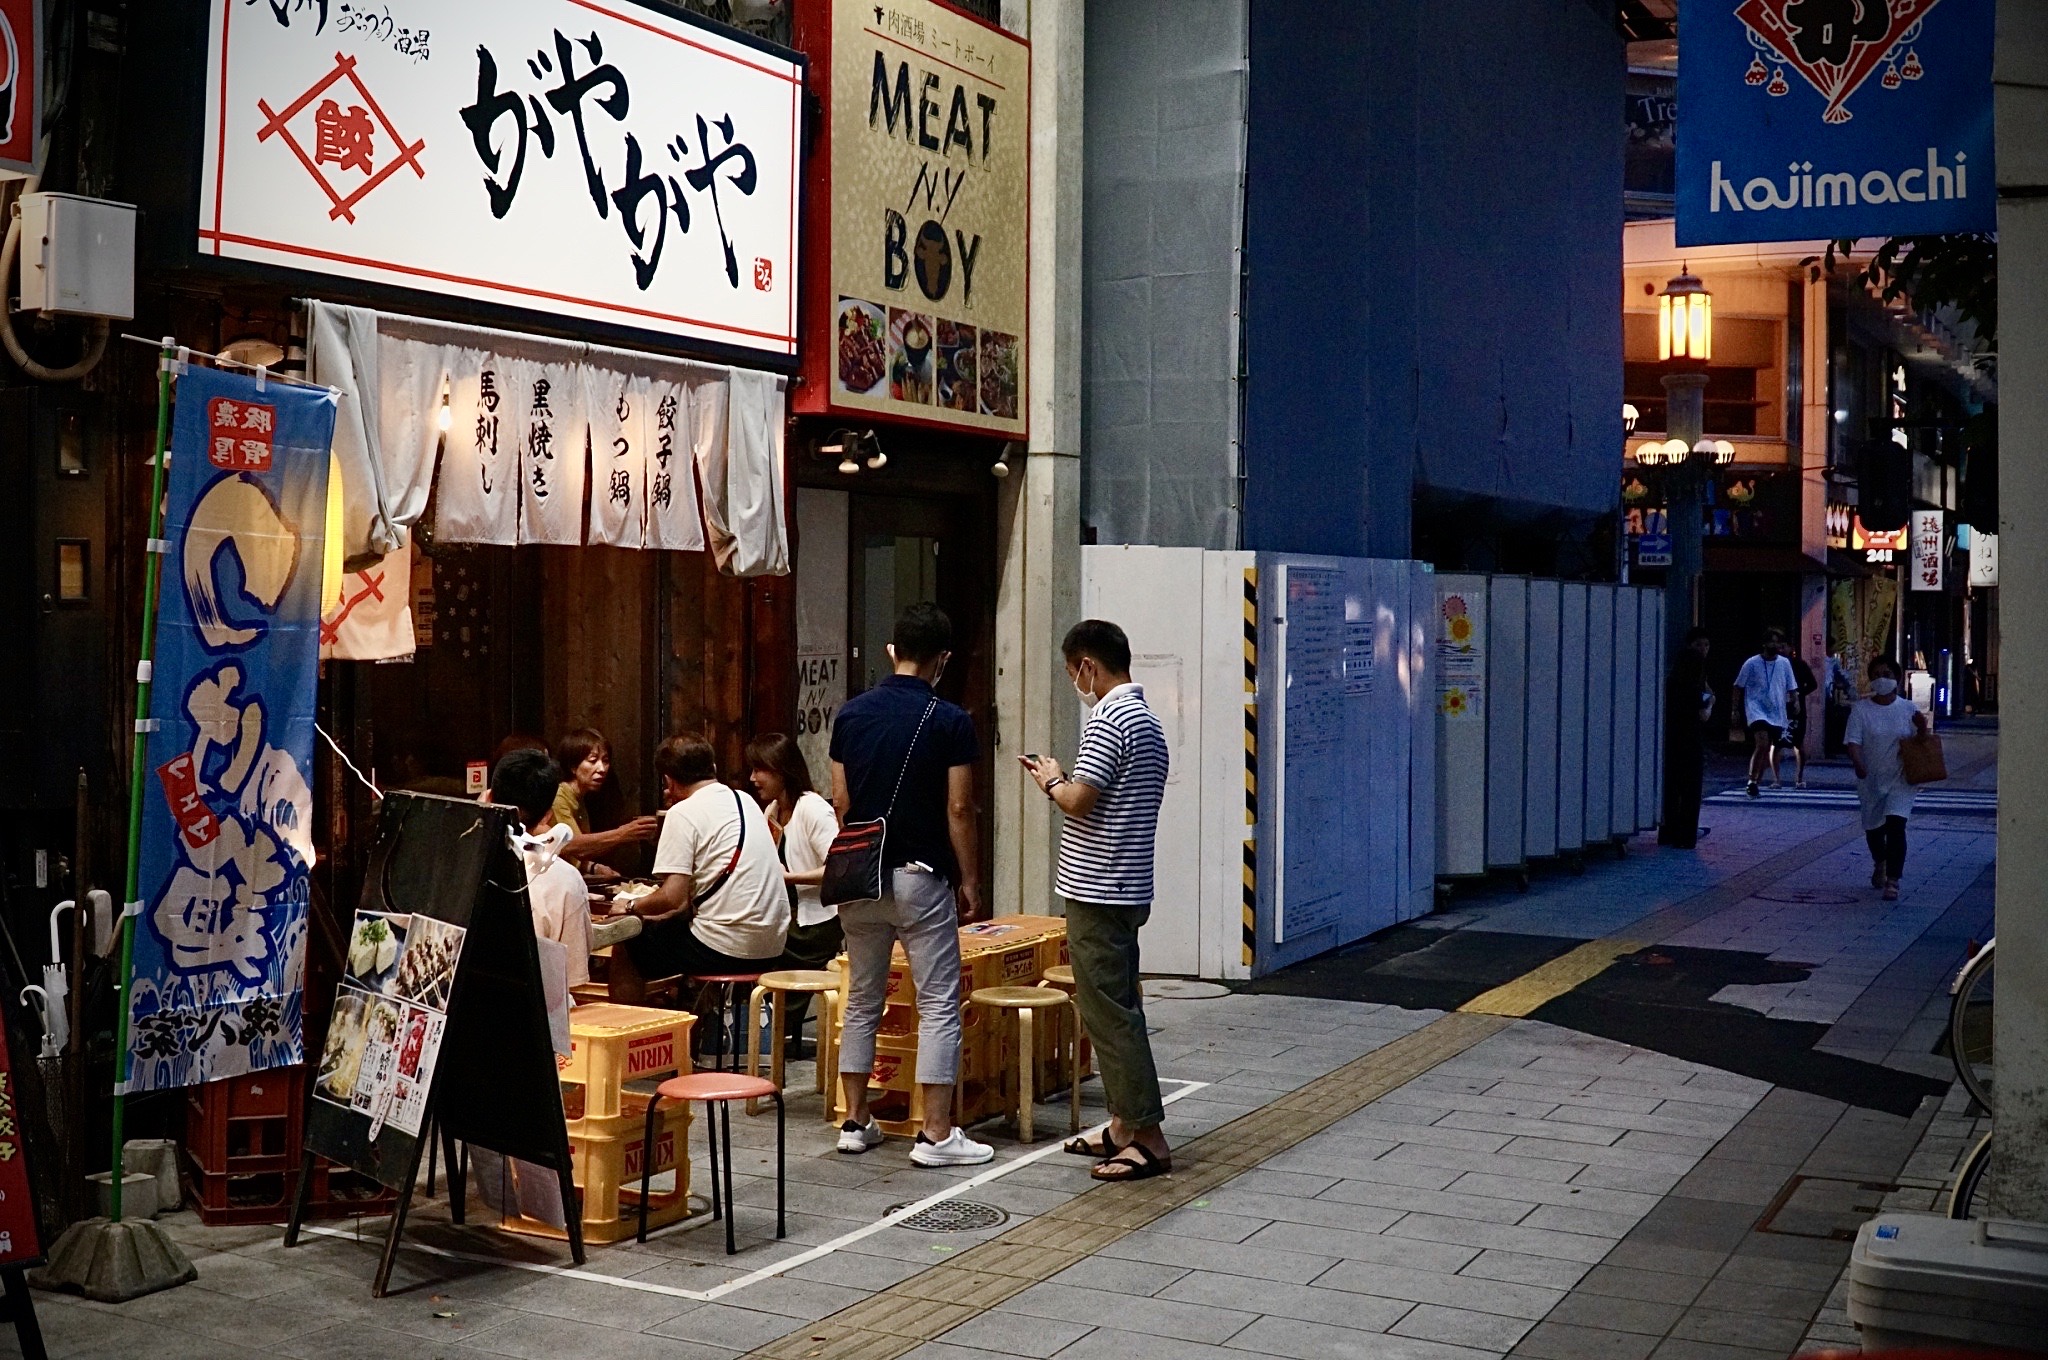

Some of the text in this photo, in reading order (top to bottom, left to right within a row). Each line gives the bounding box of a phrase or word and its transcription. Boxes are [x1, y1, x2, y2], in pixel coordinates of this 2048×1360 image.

[888, 8, 994, 74] 肉酒場 ミートボーイ
[314, 98, 375, 177] 餃
[459, 27, 757, 291] がやがや
[868, 49, 999, 172] MEAT
[1710, 147, 1967, 213] kajimachi
[884, 206, 982, 310] BOY
[474, 369, 501, 496] 馬刺し
[526, 379, 554, 498] 黒焼き
[609, 391, 631, 508] もつ鍋
[650, 395, 679, 510] 餃子鍋
[1922, 515, 1943, 587] 遠州酒場
[628, 1043, 673, 1073] KIRIN
[625, 1140, 674, 1176] KIIN
